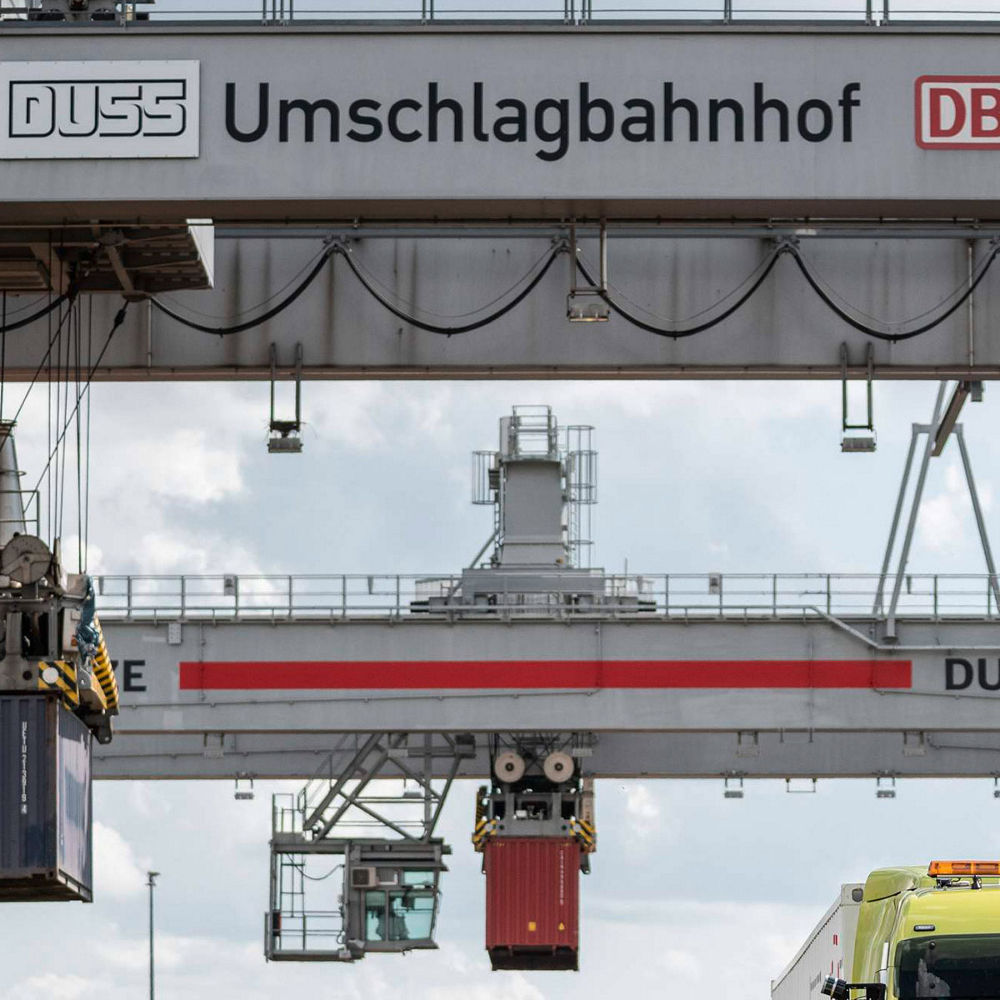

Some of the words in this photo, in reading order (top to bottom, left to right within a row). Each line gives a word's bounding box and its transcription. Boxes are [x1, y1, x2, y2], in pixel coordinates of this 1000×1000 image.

[9, 79, 187, 138] DUSS
[225, 82, 861, 162] Umschlagbahnhof
[110, 659, 147, 692] E
